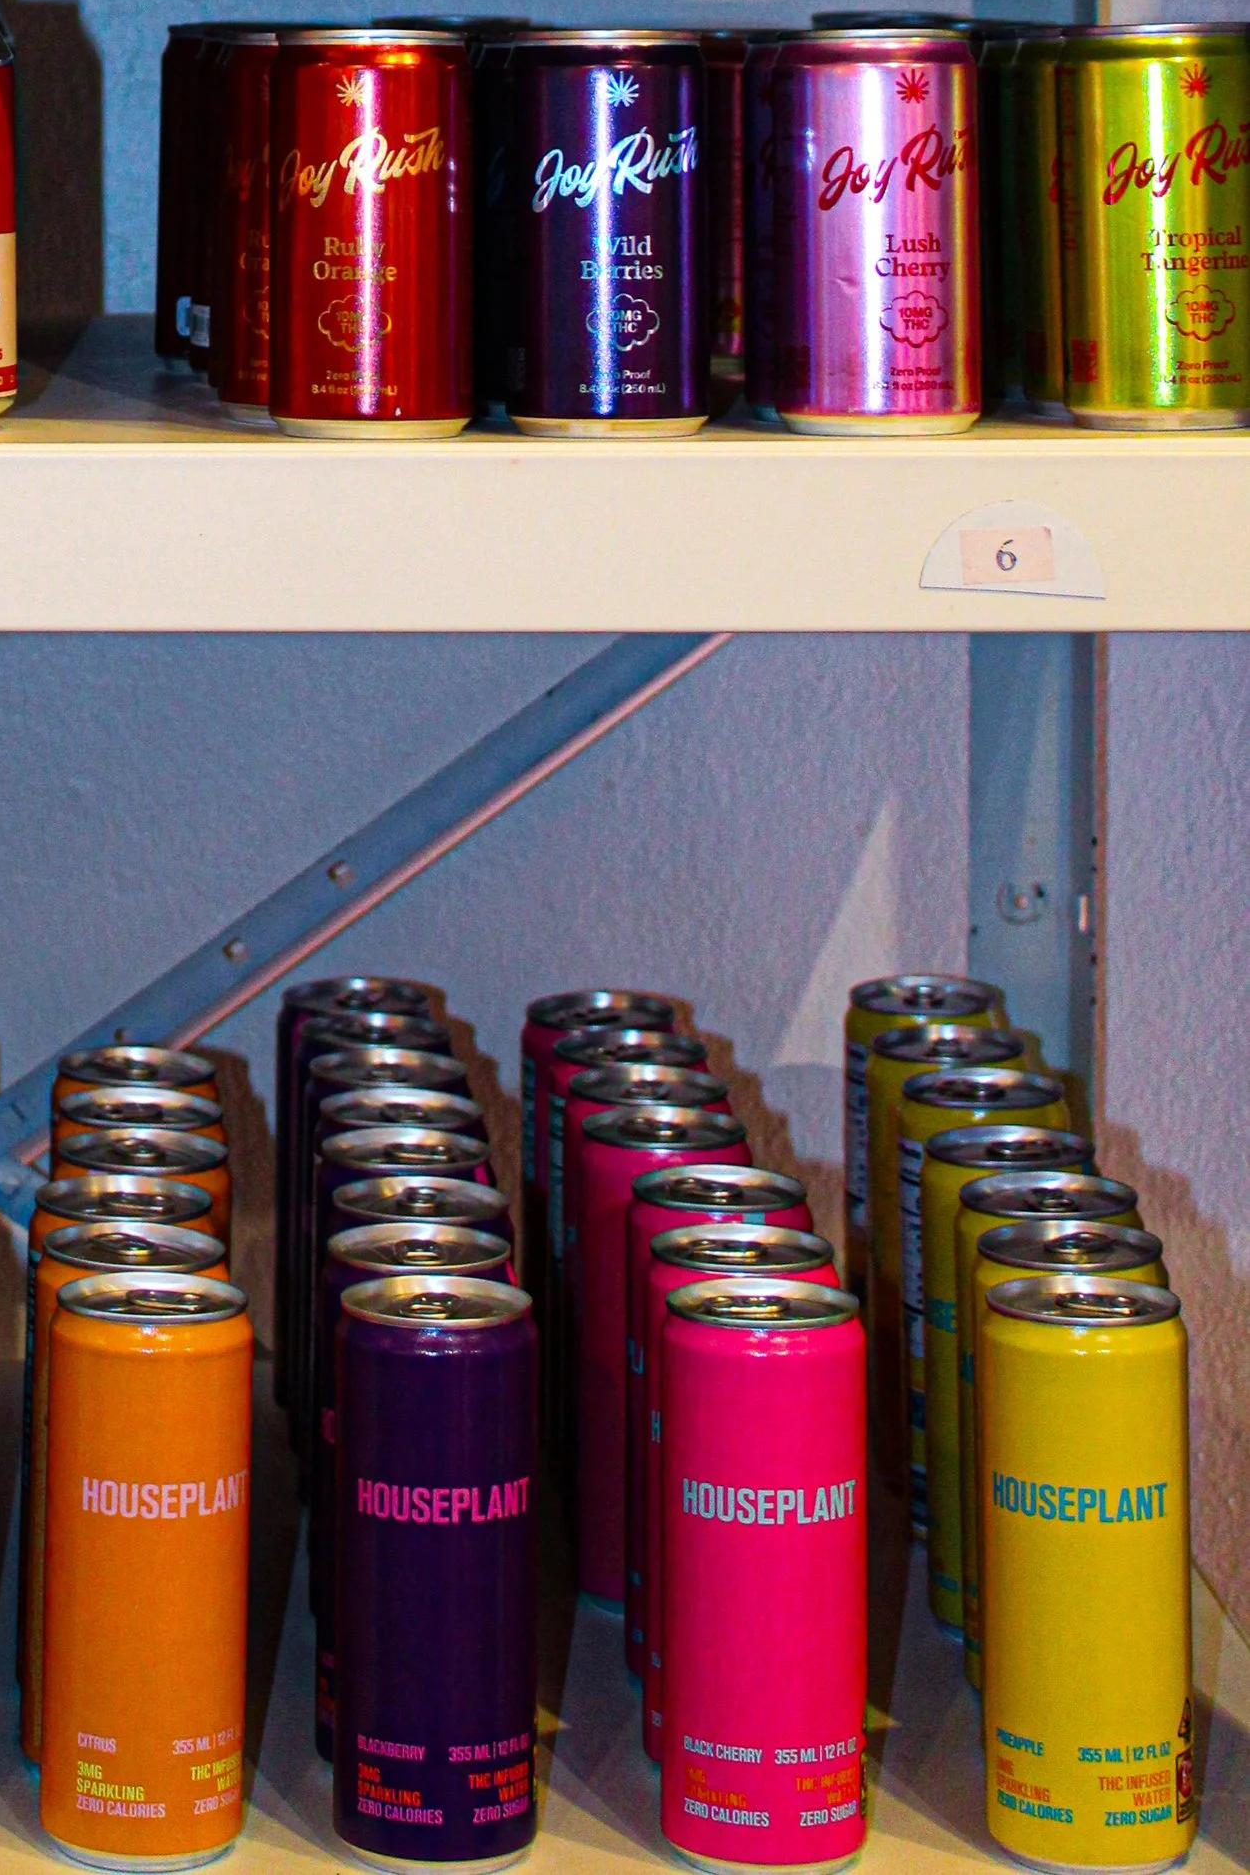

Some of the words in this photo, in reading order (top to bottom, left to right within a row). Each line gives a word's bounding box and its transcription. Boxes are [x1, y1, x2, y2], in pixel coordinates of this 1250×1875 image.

[340, 125, 444, 195] Rush
[532, 149, 613, 213] Joy
[612, 125, 698, 195] Rush
[1103, 141, 1180, 205] Joy
[819, 145, 898, 211] Joy
[885, 233, 941, 253] Lush
[1150, 225, 1242, 250] Tropical
[875, 257, 951, 283] Cherry
[1141, 253, 1248, 277] Tangerine
[996, 539, 1017, 571] 6
[82, 1469, 248, 1519] HOUSEPLANT
[358, 1477, 529, 1524] HOUSEPLANT
[683, 1478, 856, 1524] HOUSEPLANT
[994, 1471, 1168, 1523] HOUSEPLANT
[449, 1745, 472, 1763] 355
[474, 1743, 491, 1761] ML
[684, 1733, 713, 1756] BLACK
[716, 1741, 762, 1764] CHERRY
[77, 1777, 144, 1801] SPARKLING
[1099, 1775, 1124, 1792] THC
[1133, 1787, 1171, 1808] WATER
[77, 1794, 104, 1814] ZERO
[107, 1800, 166, 1819] CALORIES
[358, 1796, 382, 1817] ZERO
[385, 1802, 442, 1826] CALORIES
[684, 1796, 709, 1820] ZERO
[711, 1807, 769, 1828] CALORIES
